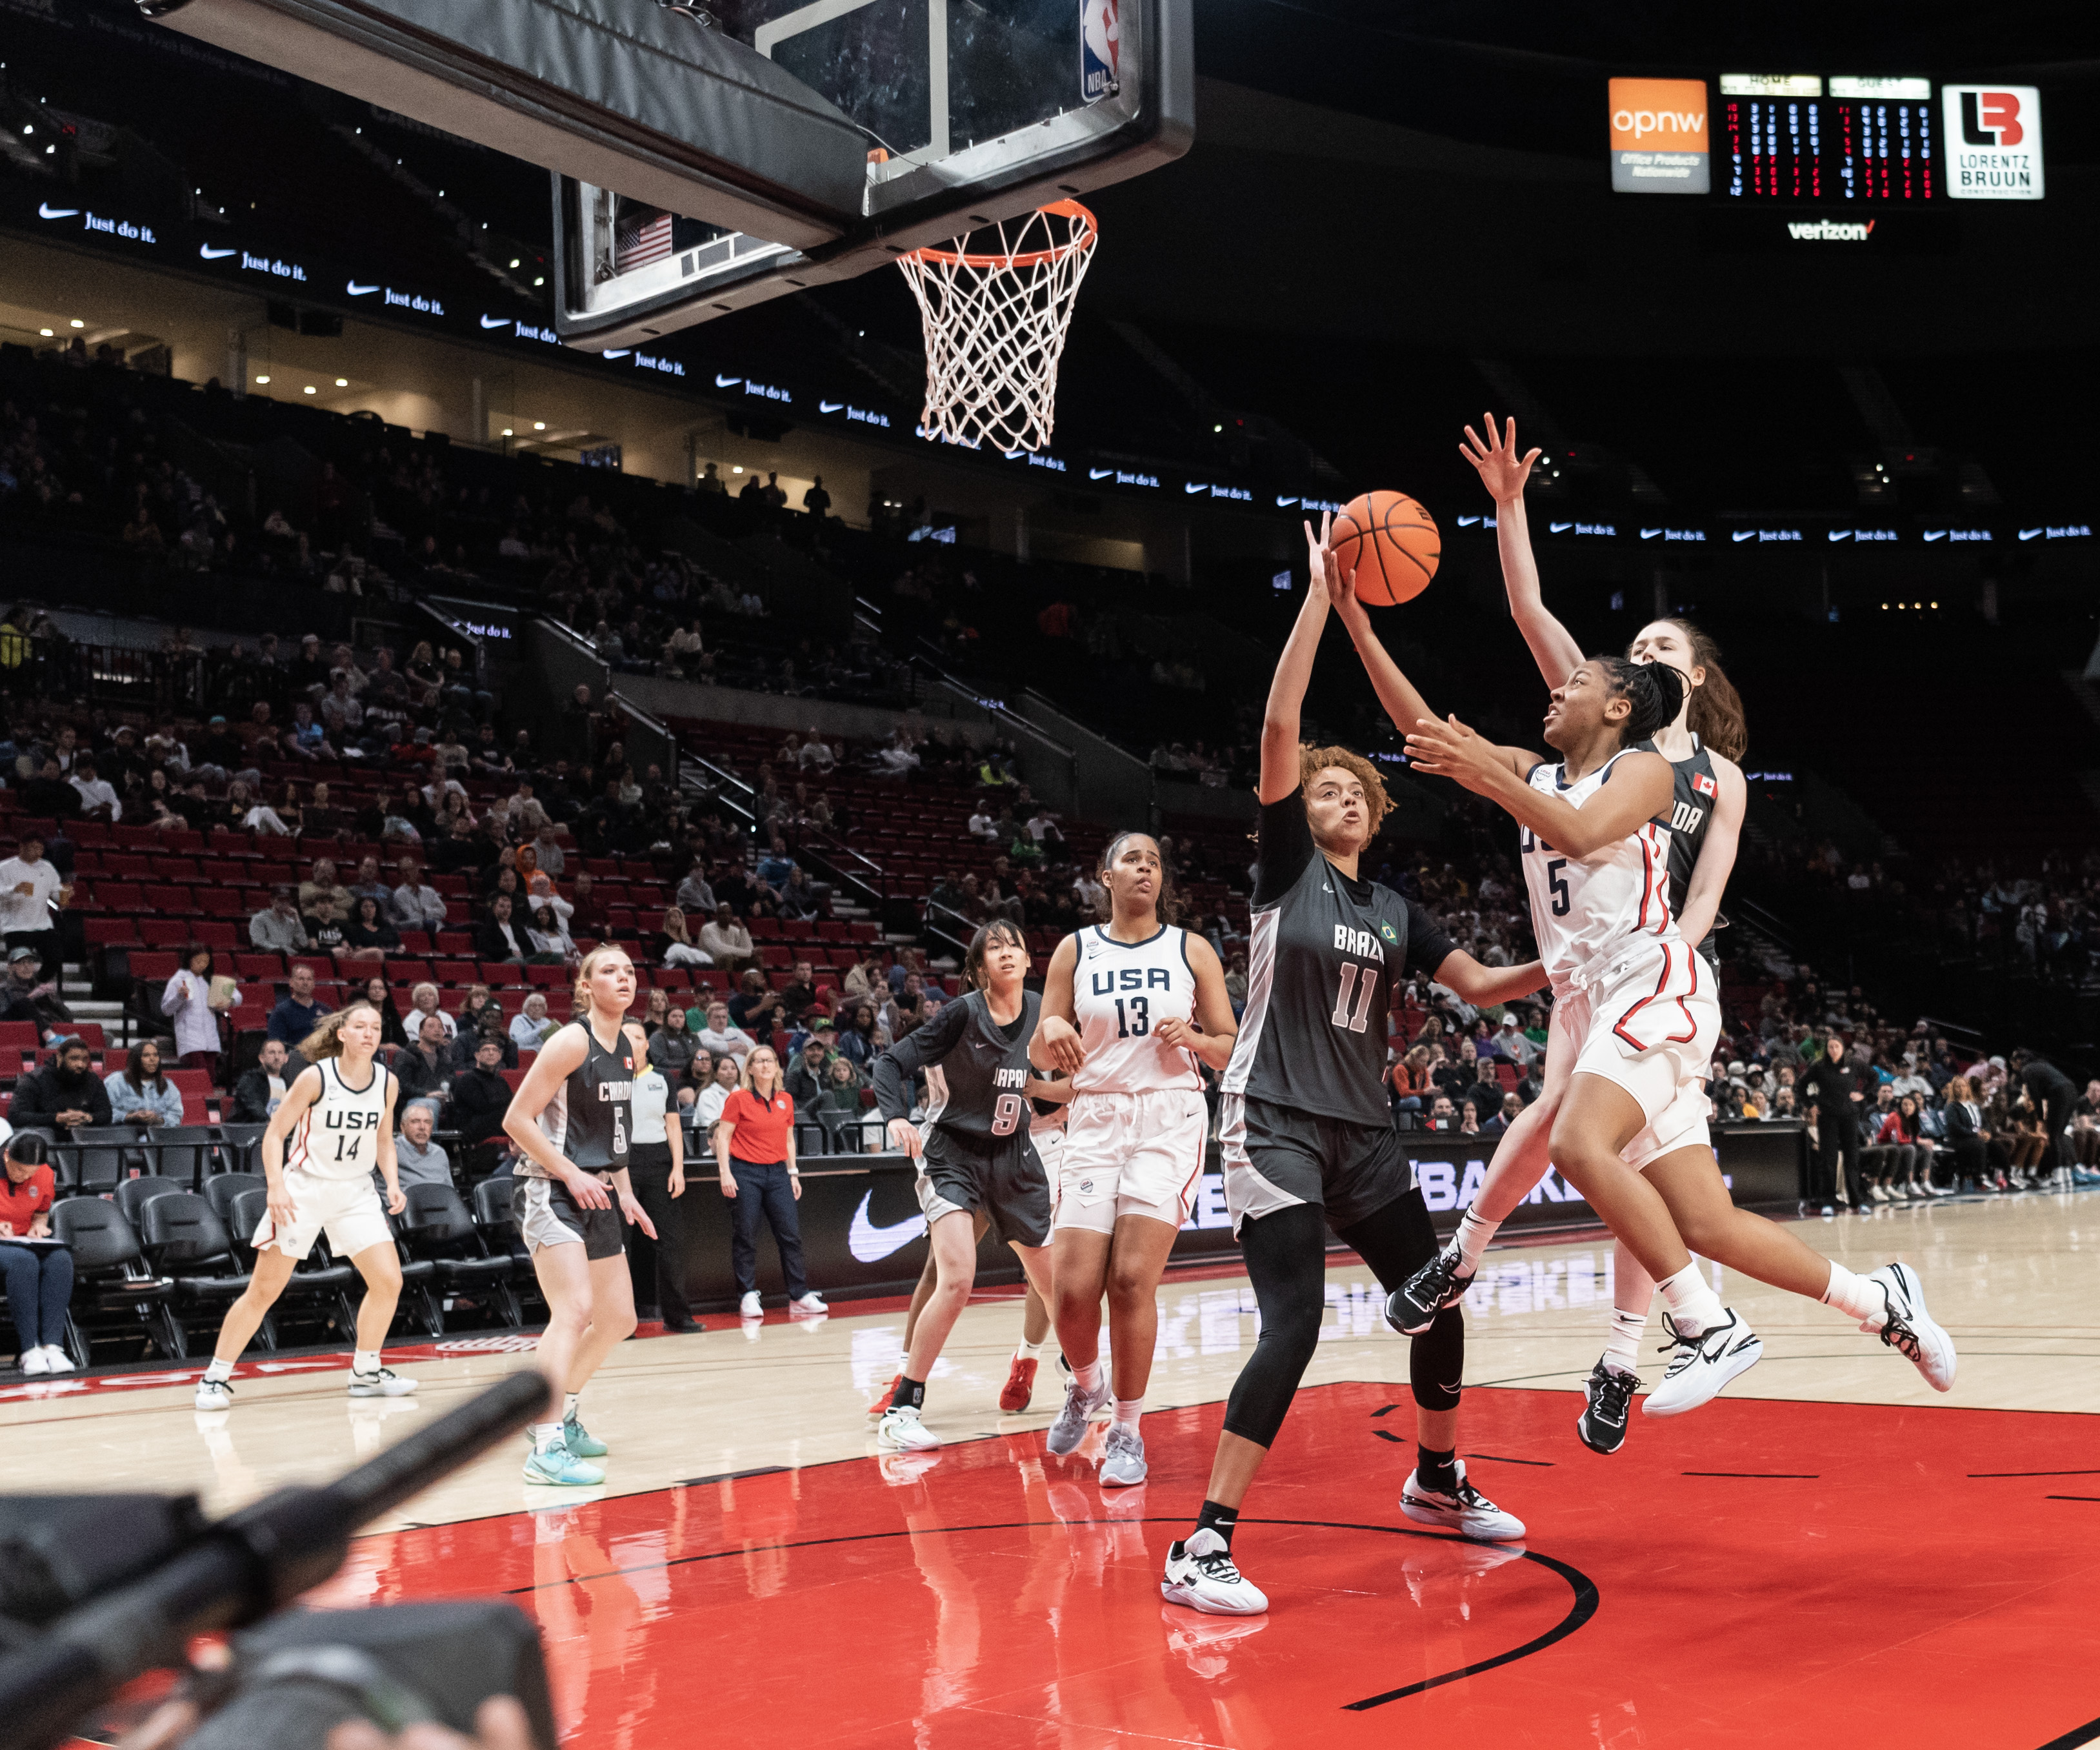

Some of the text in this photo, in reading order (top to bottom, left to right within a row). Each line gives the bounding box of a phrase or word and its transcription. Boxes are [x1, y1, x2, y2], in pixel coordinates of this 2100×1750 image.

[1088, 69, 1107, 94] NBA
[1750, 75, 1791, 86] HOME
[1613, 110, 1705, 139] opnw
[1959, 154, 2029, 170] LORENTZ
[1961, 170, 2030, 187] BRUUN
[84, 211, 156, 244] Just do it.
[1787, 218, 1868, 241] verizon
[241, 251, 307, 281] Just do it.
[384, 287, 445, 316] Just do it.
[515, 320, 557, 343] Just do
[635, 351, 686, 376] Just do it.
[745, 379, 792, 403] Just do it.
[846, 405, 866, 421] Just
[866, 410, 880, 425] do
[1028, 451, 1045, 467] Just
[1045, 457, 1057, 469] do
[1116, 470, 1135, 484] Just
[1135, 474, 1149, 486] do
[1211, 484, 1229, 498] Just
[1229, 487, 1243, 499] do
[1301, 498, 1319, 510] Just
[1319, 501, 1332, 512] do
[1483, 515, 1497, 528] Jus
[1575, 521, 1593, 535] Just
[1593, 523, 1606, 535] do
[2046, 526, 2065, 539] Just
[2066, 525, 2079, 537] do
[1665, 528, 1682, 541] Just
[1682, 530, 1695, 541] do
[1759, 530, 1777, 543] Just
[1777, 530, 1792, 541] do
[1854, 529, 1874, 542] Just
[1874, 529, 1887, 541] do
[1949, 529, 1968, 542] Just
[1968, 529, 1981, 541] do
[1546, 858, 1571, 917] 5
[1092, 967, 1170, 996] USA
[1331, 961, 1378, 1034] 11
[1114, 996, 1149, 1038] 13
[325, 1110, 379, 1130] USA
[990, 1092, 1022, 1136] 9
[613, 1106, 628, 1154] 5
[334, 1134, 361, 1162] 14
